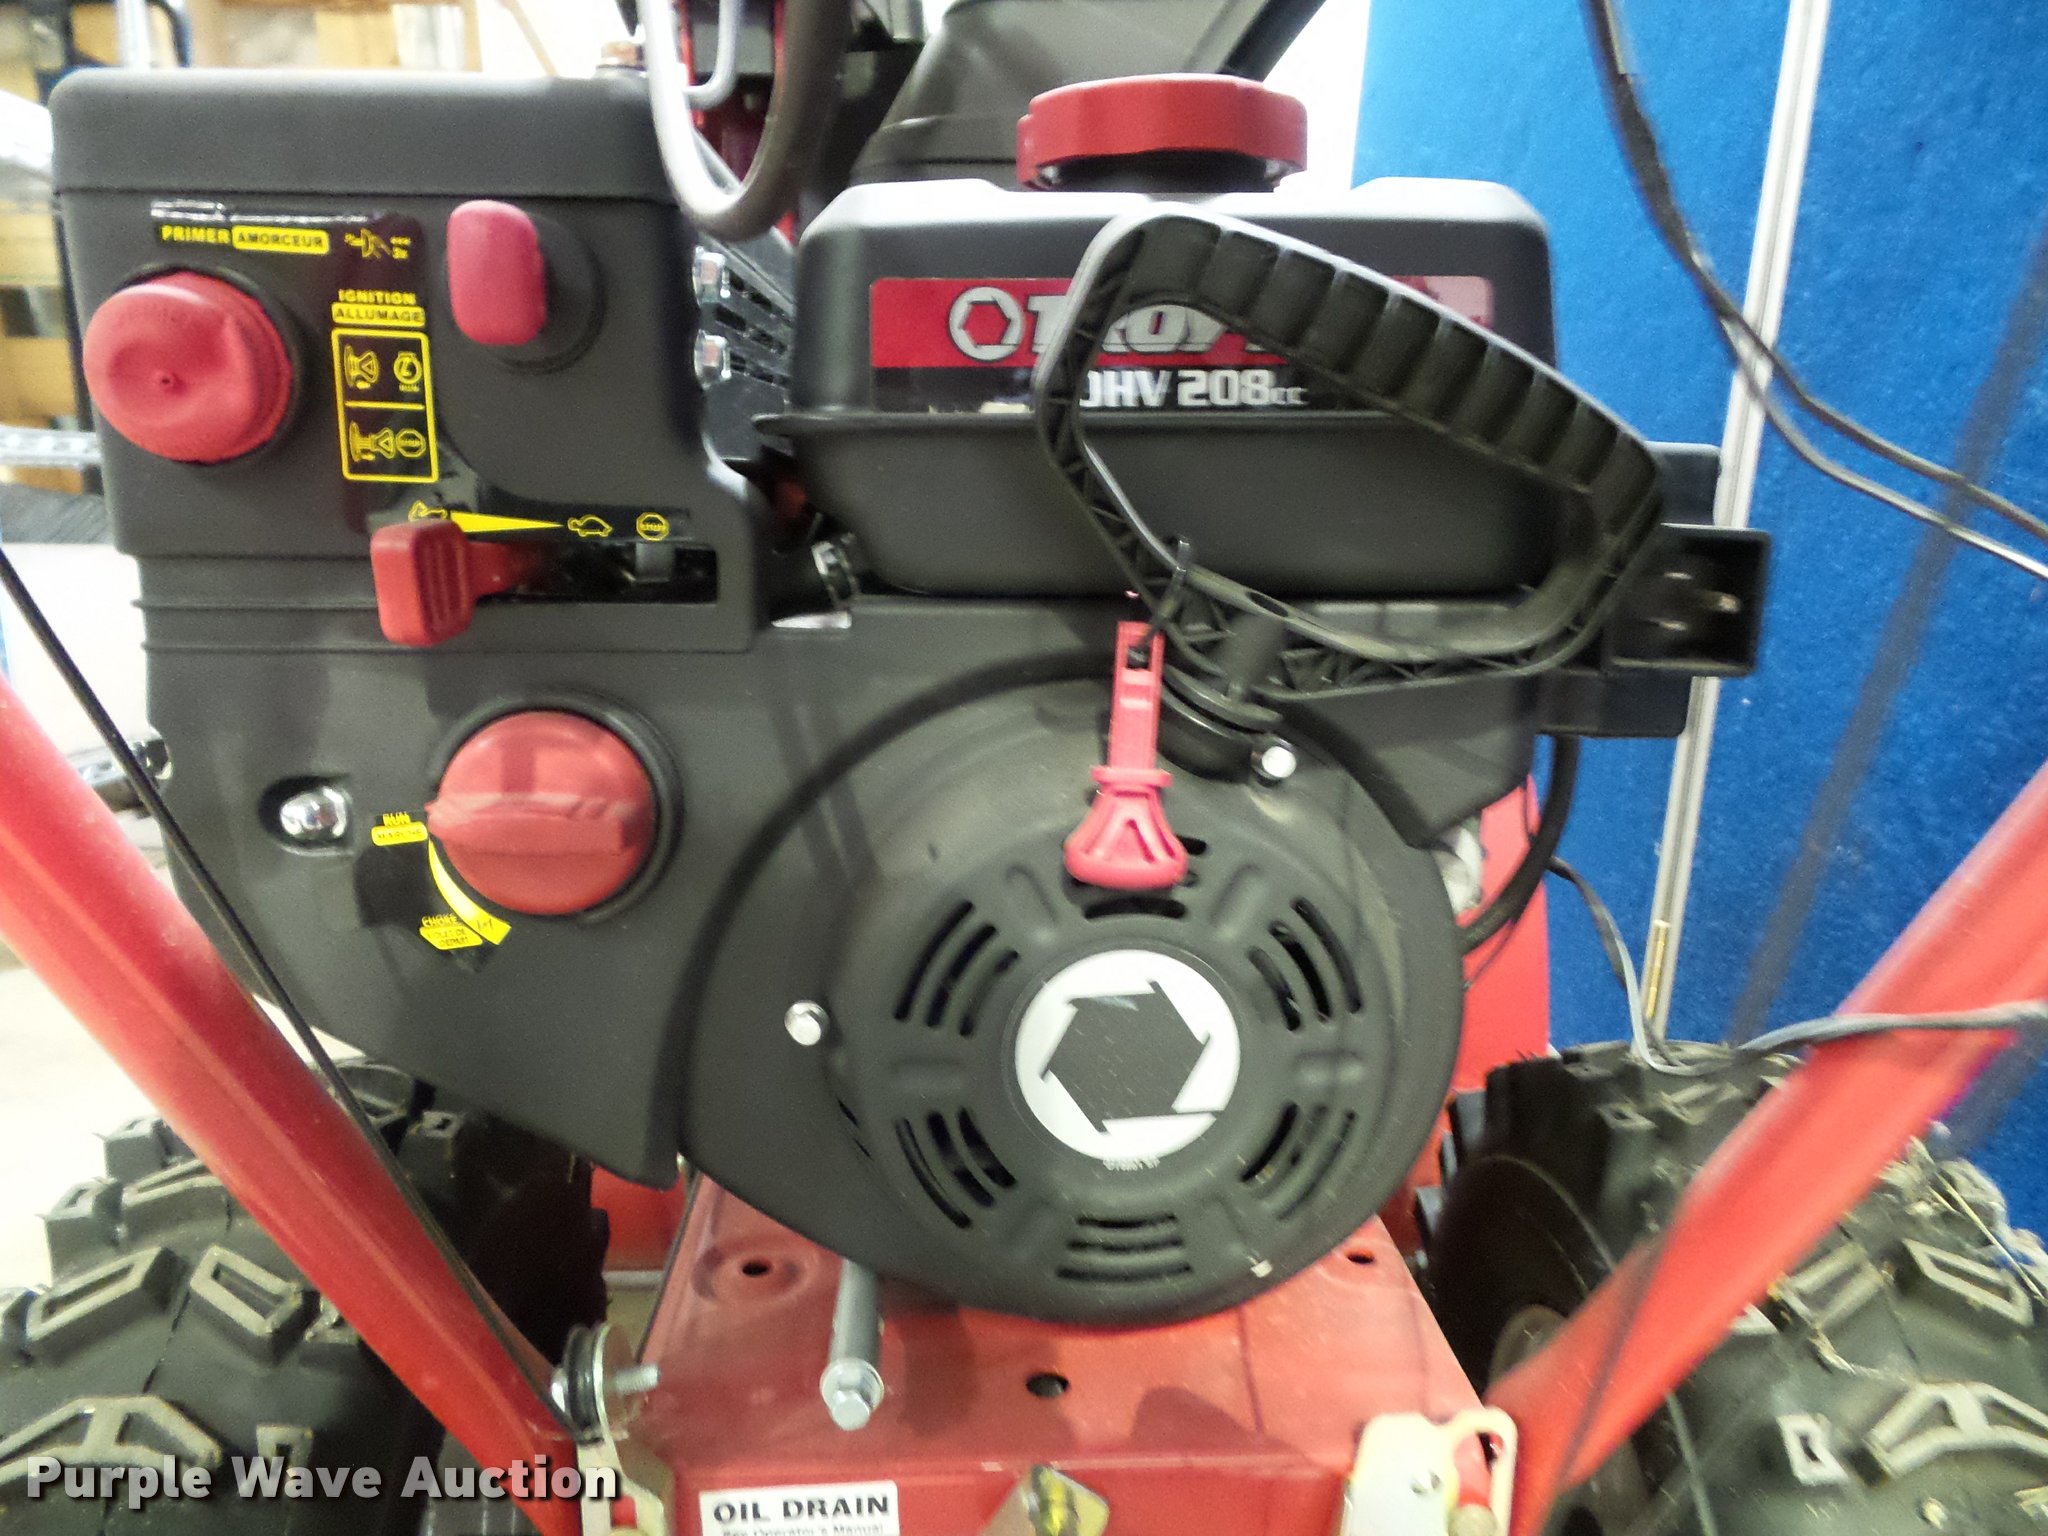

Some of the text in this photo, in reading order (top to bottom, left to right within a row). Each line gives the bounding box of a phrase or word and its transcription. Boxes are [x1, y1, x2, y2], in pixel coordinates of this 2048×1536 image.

[161, 224, 324, 248] PRIMER AMORCEUR
[337, 288, 416, 306] IGNITION
[335, 306, 423, 323] ALLUMAGE
[713, 1496, 889, 1522] OIL DRAIN
